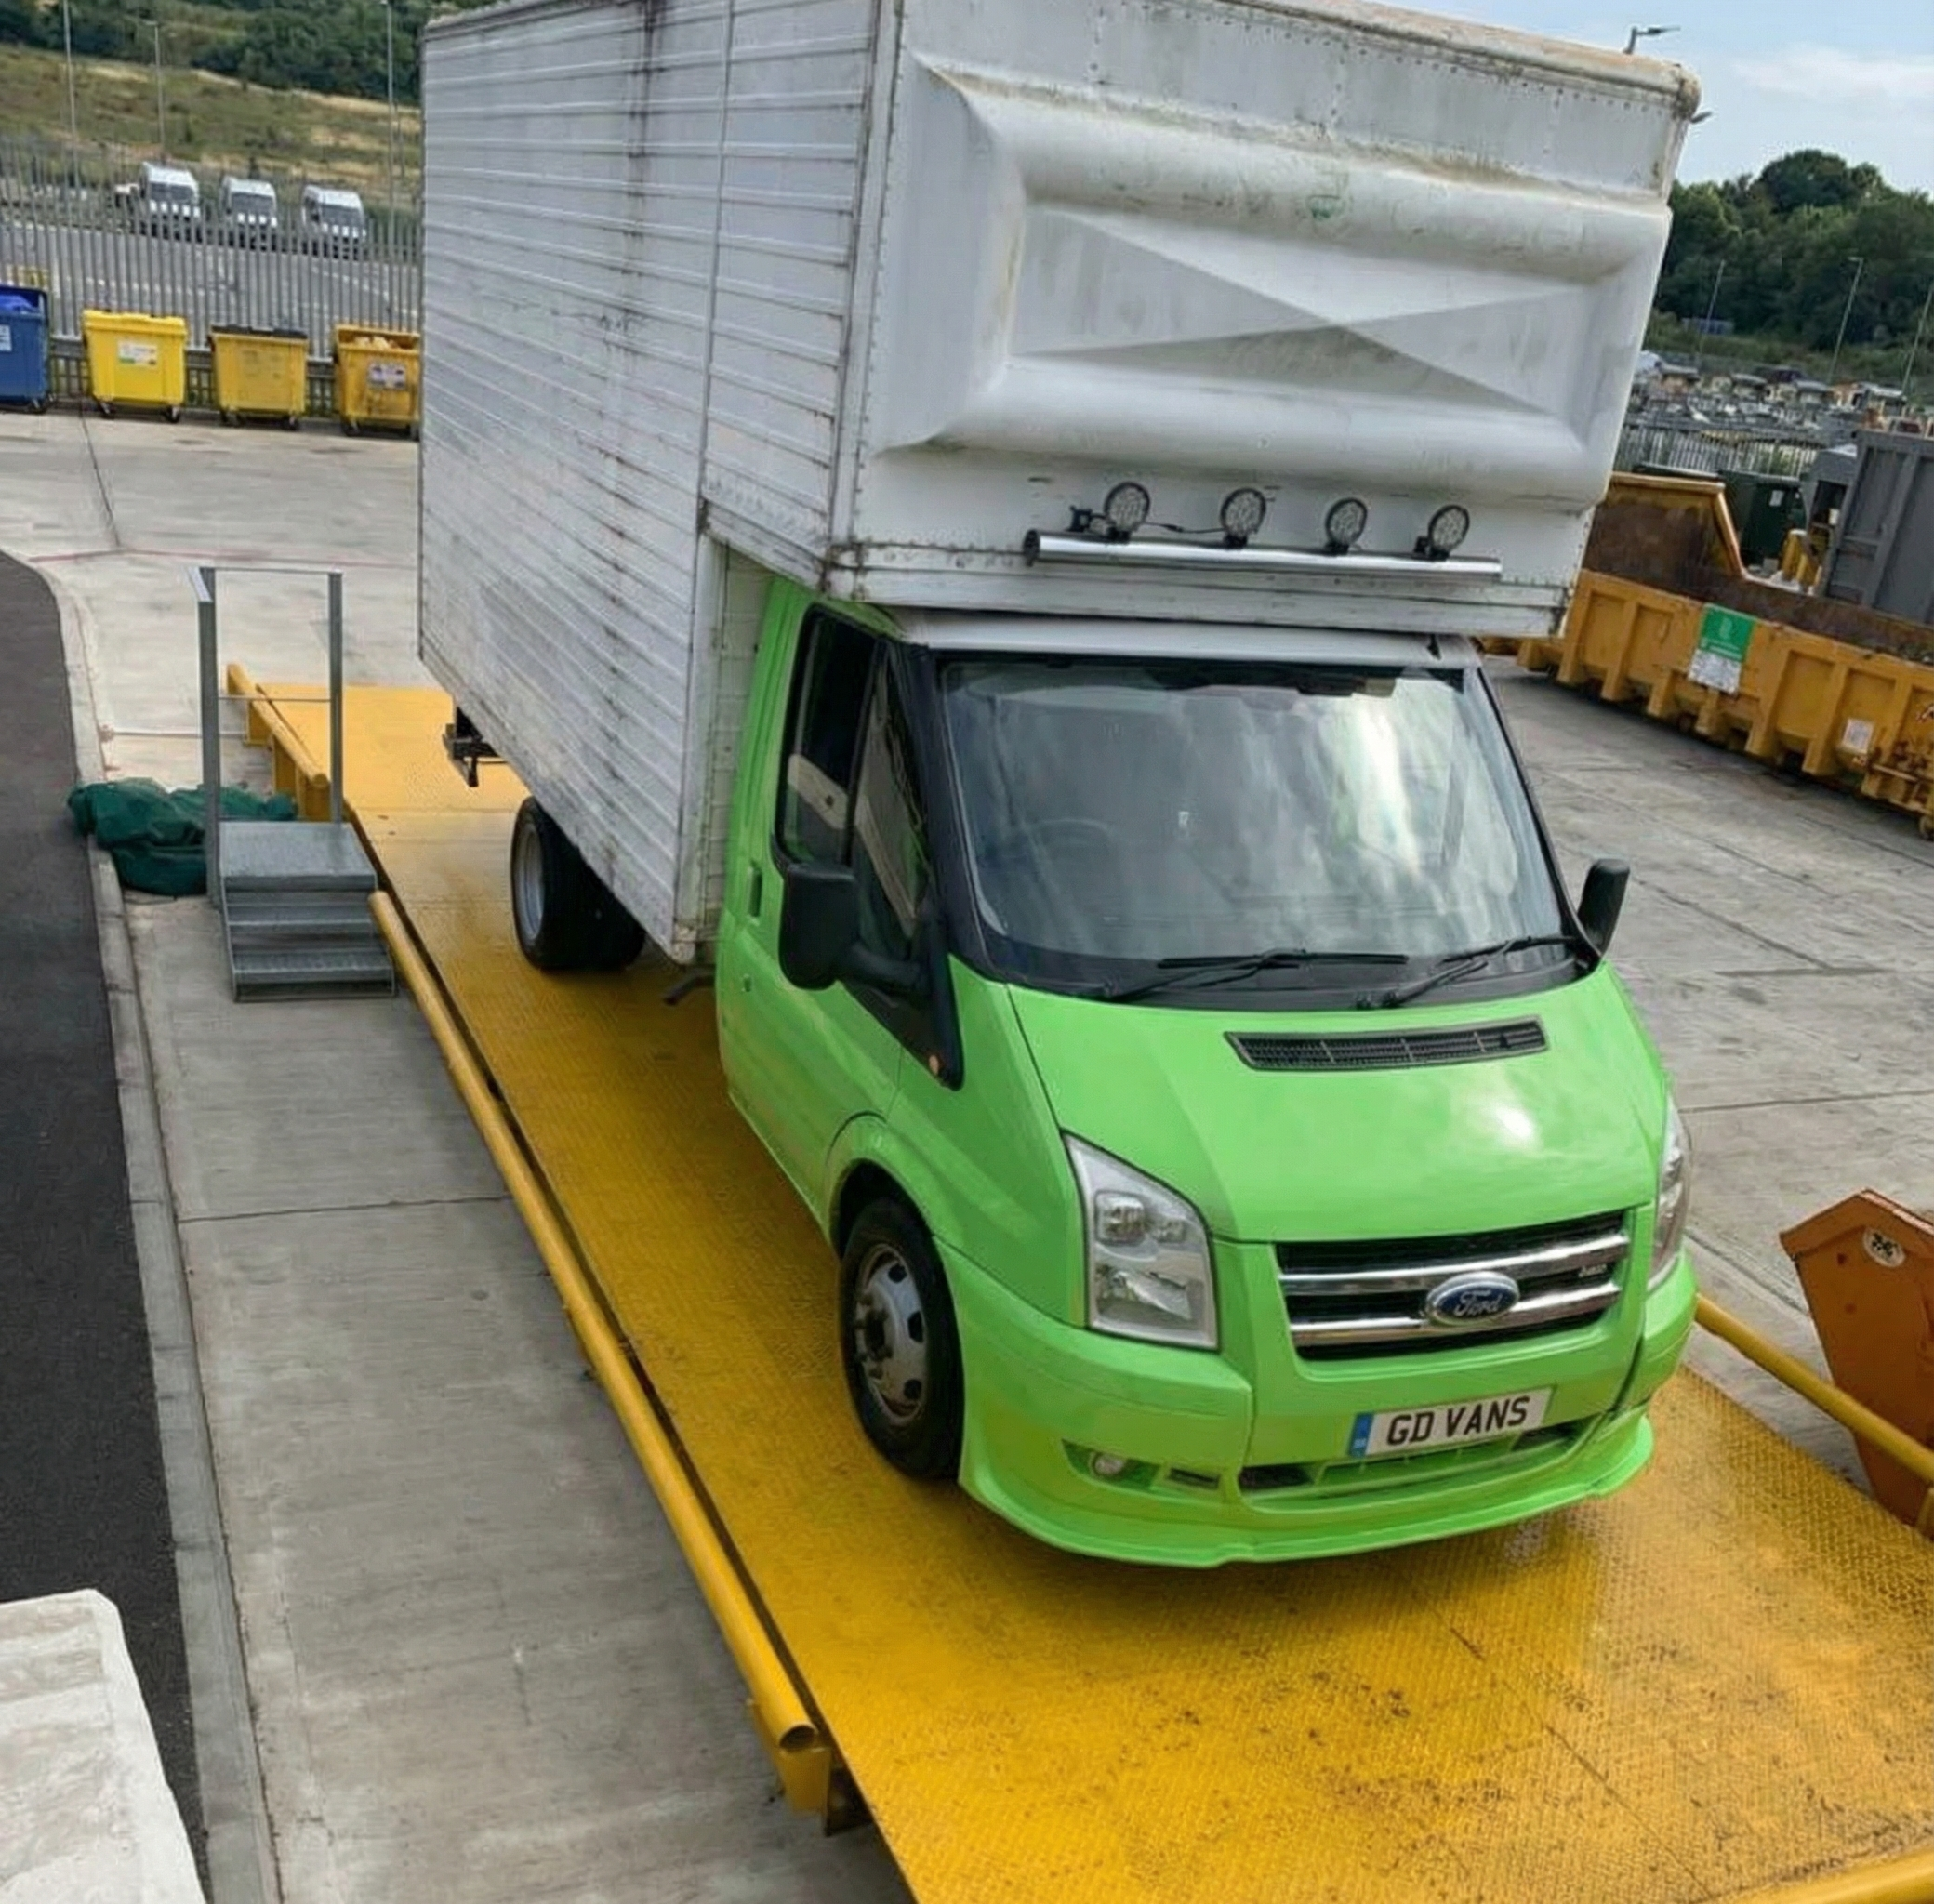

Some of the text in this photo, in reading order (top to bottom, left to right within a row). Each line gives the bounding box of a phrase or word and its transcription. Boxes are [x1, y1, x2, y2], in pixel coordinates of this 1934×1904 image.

[1454, 1289, 1503, 1316] Ford
[1386, 1395, 1530, 1447] GD VANS
